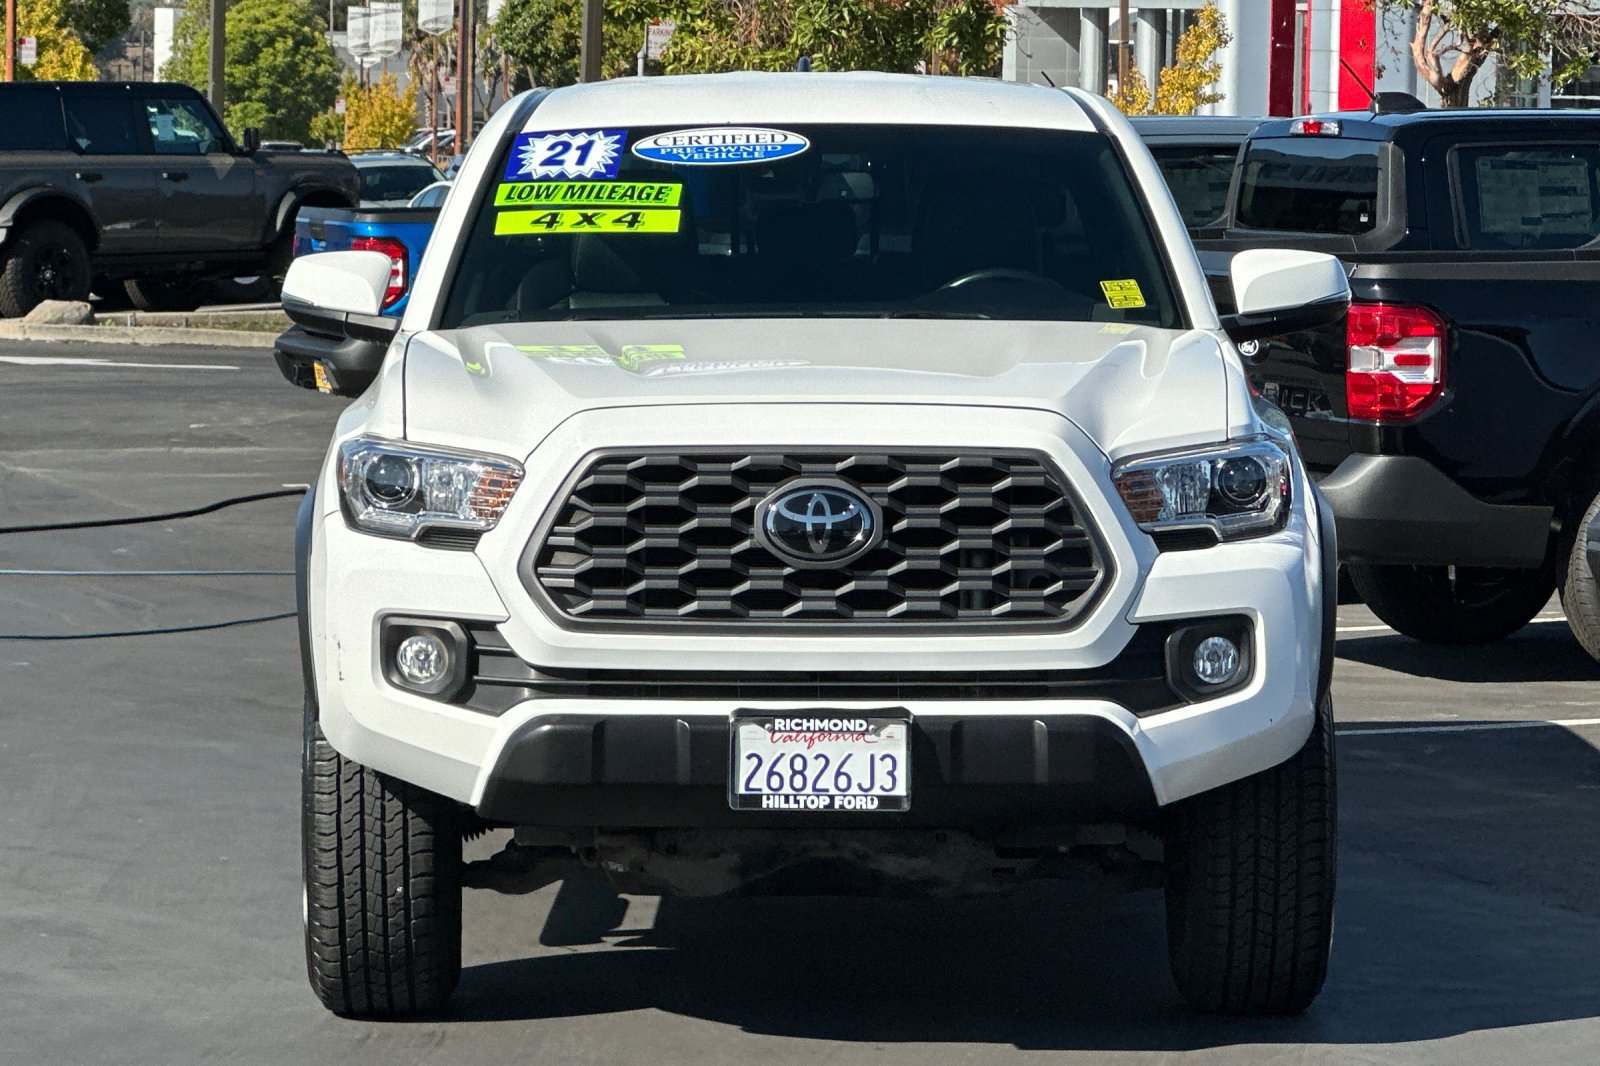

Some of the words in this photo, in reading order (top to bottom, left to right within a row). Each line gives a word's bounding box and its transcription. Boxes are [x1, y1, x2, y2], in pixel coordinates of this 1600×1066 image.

[653, 133, 788, 147] CERTIFIED
[538, 139, 597, 167] 21
[660, 144, 782, 155] PRE-OWNED
[678, 151, 765, 160] VEHICLE
[504, 184, 562, 202] LOW
[561, 184, 673, 204] MILEAGE
[530, 211, 564, 231] 4
[612, 211, 646, 230] 4
[774, 718, 868, 732] RICHMOND
[744, 752, 898, 793] 26826J3
[761, 795, 831, 809] HILLTOP
[833, 795, 879, 810] FORD
